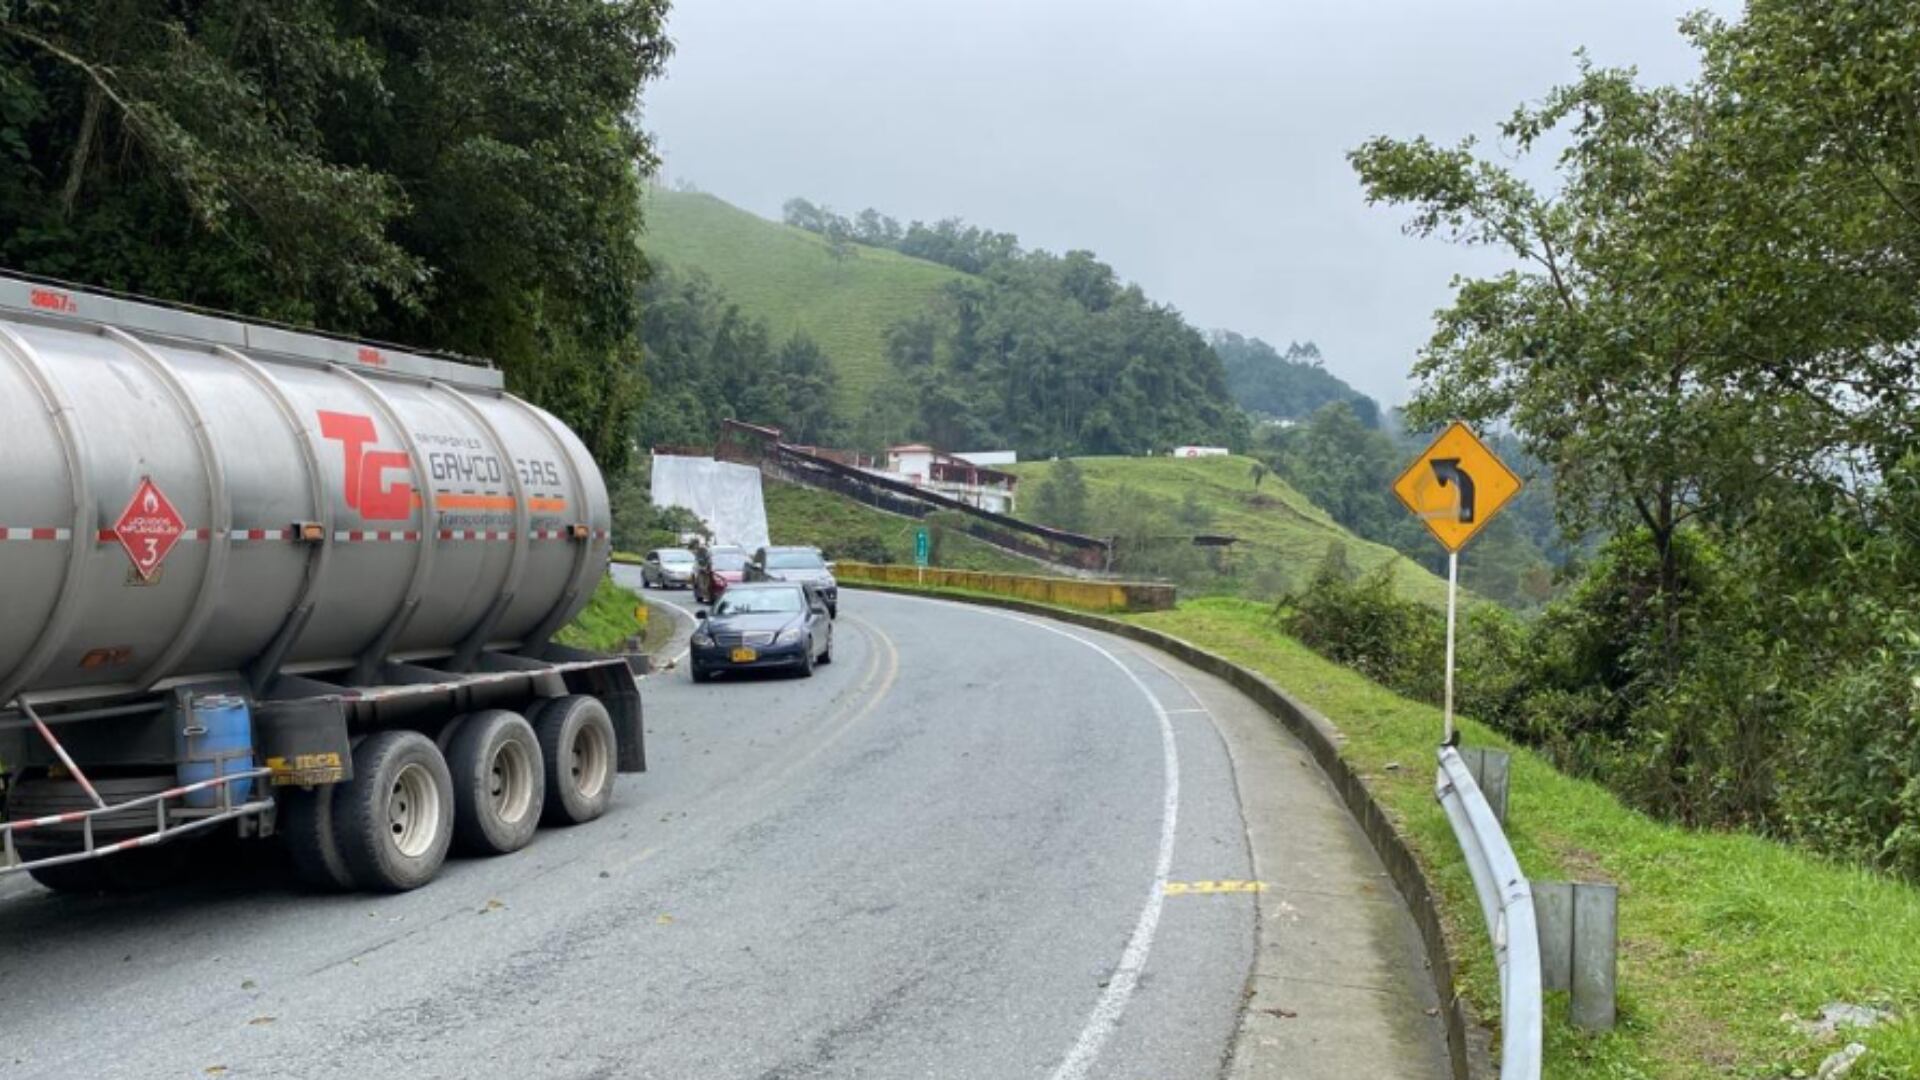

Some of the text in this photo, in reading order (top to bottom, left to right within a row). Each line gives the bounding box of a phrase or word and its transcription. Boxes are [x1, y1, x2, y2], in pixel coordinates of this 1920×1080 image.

[316, 409, 411, 520] TG
[429, 452, 501, 482] GAYCO
[141, 538, 159, 566] 3
